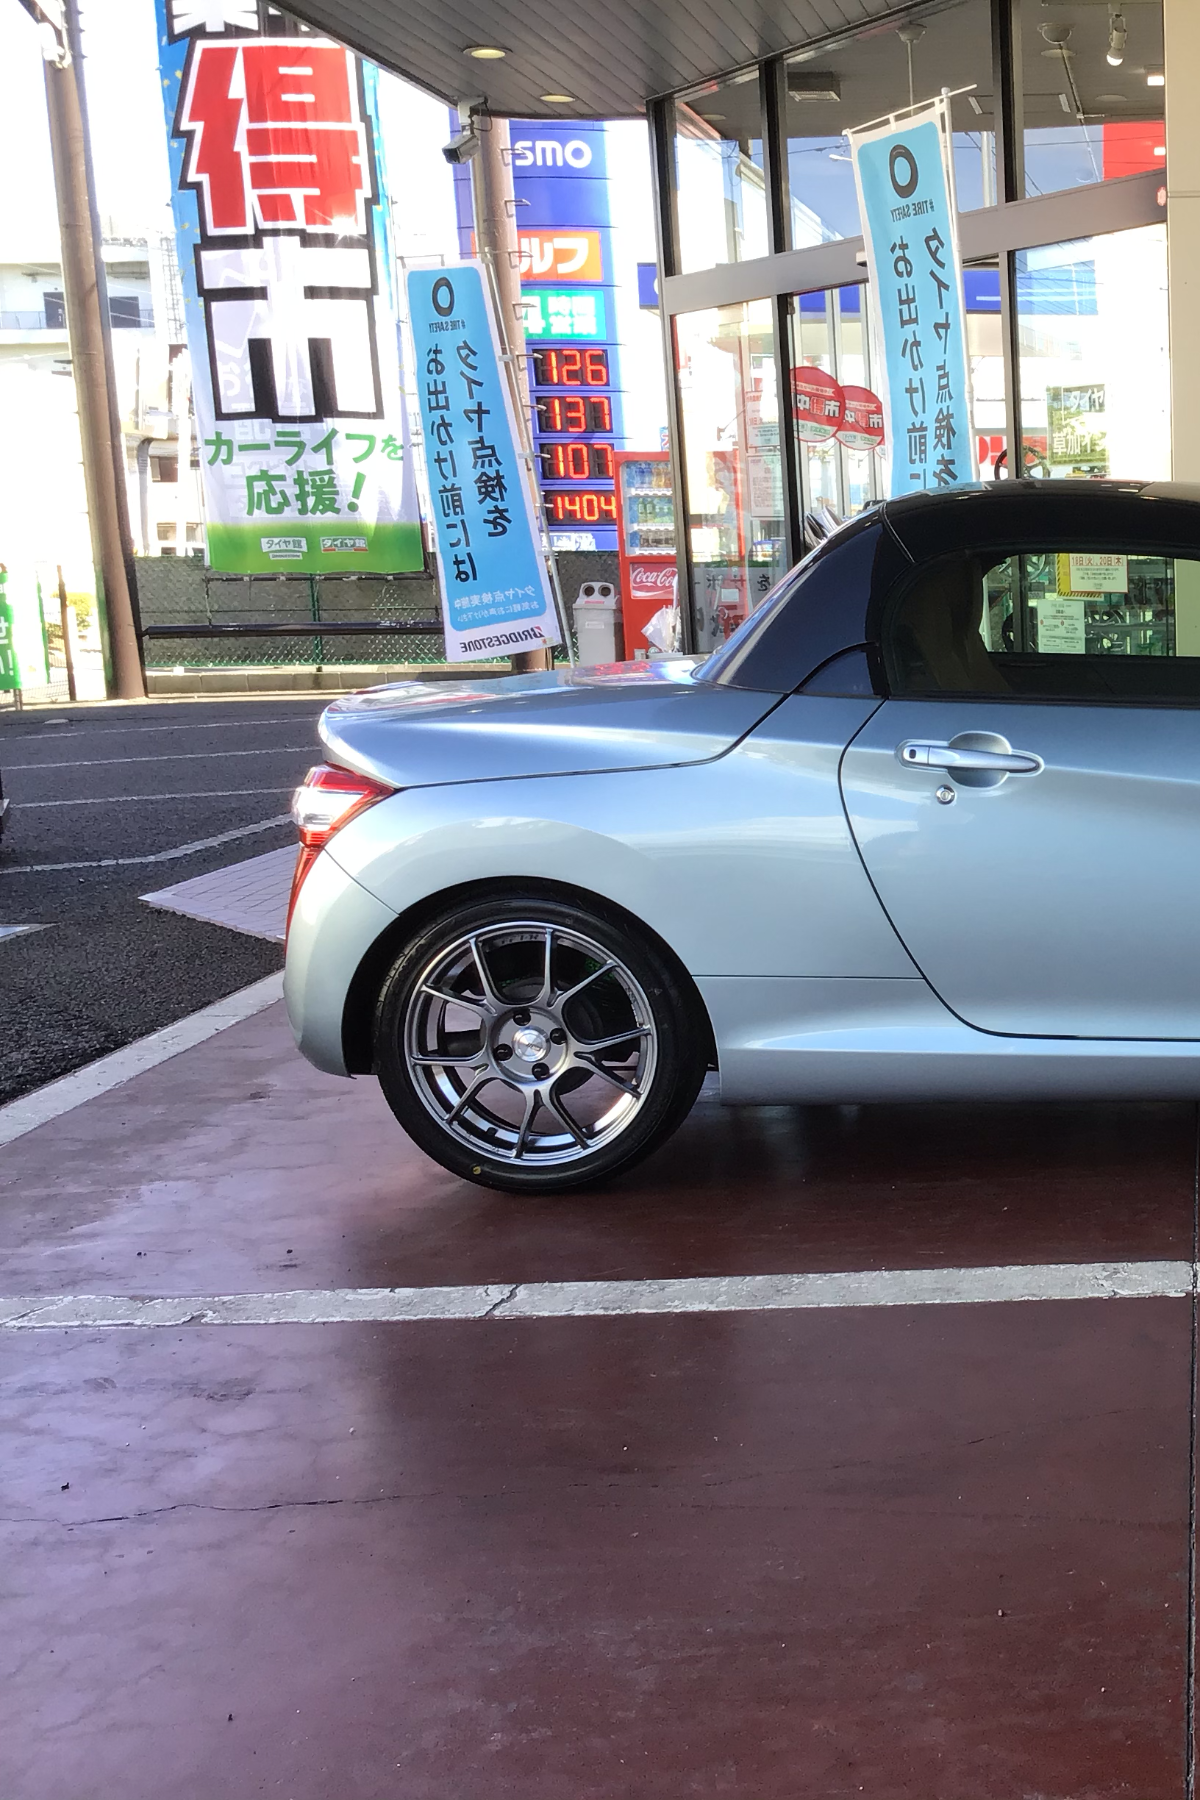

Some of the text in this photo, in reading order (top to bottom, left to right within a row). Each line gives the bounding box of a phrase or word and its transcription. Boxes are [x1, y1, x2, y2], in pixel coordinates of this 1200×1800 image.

[174, 0, 376, 416] 得市
[549, 349, 608, 385] 126
[553, 396, 611, 432] 137
[204, 427, 404, 467] カーライフを
[557, 443, 614, 479] 107
[246, 468, 367, 516] 応援!
[557, 494, 617, 521] 1404
